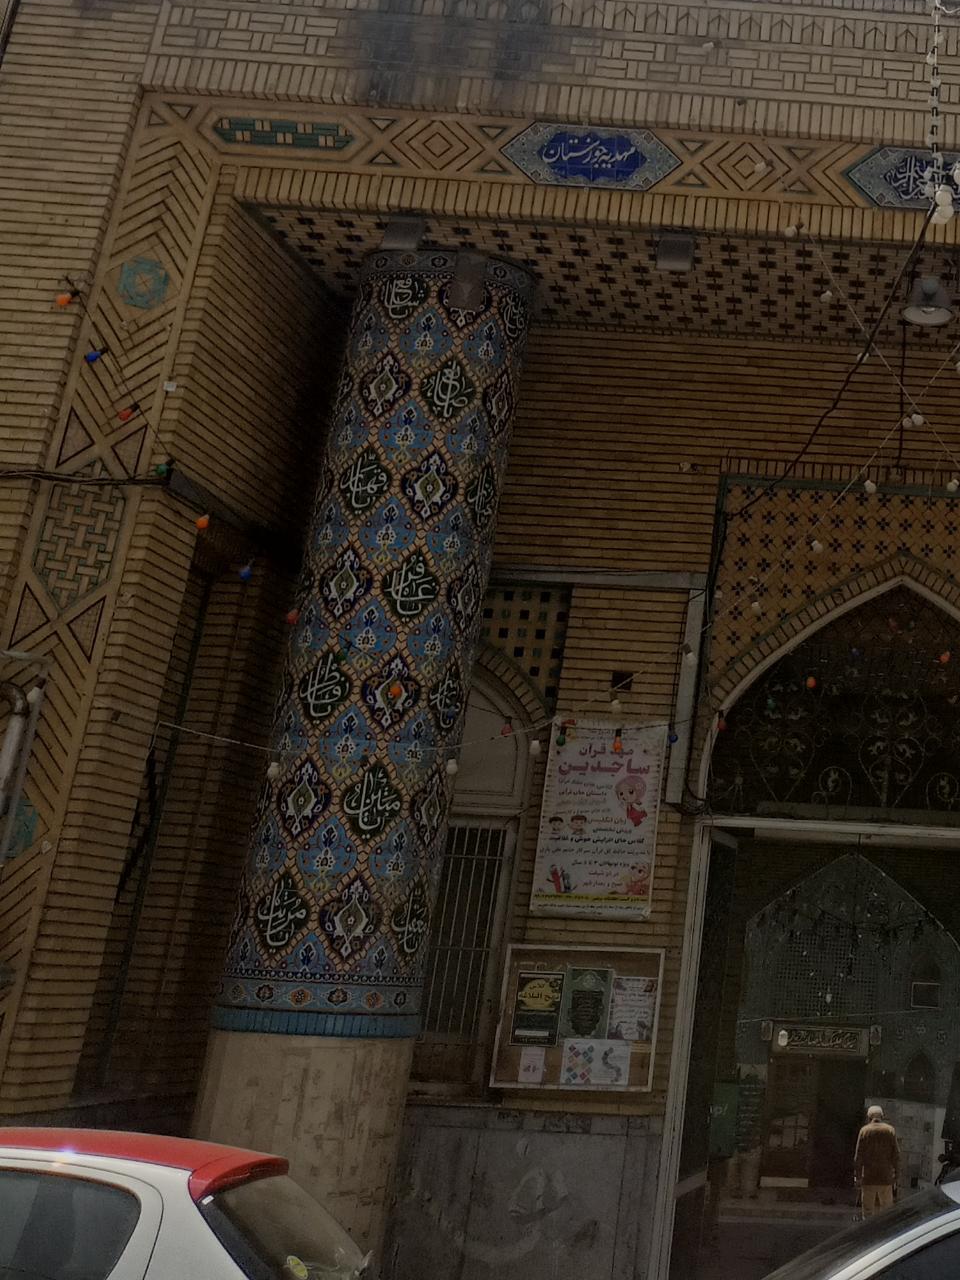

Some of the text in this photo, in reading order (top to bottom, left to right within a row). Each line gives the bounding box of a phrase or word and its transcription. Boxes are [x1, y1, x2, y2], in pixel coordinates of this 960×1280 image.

[543, 138, 637, 169] مهدیه جوزستان
[558, 758, 650, 778] ساجدین
